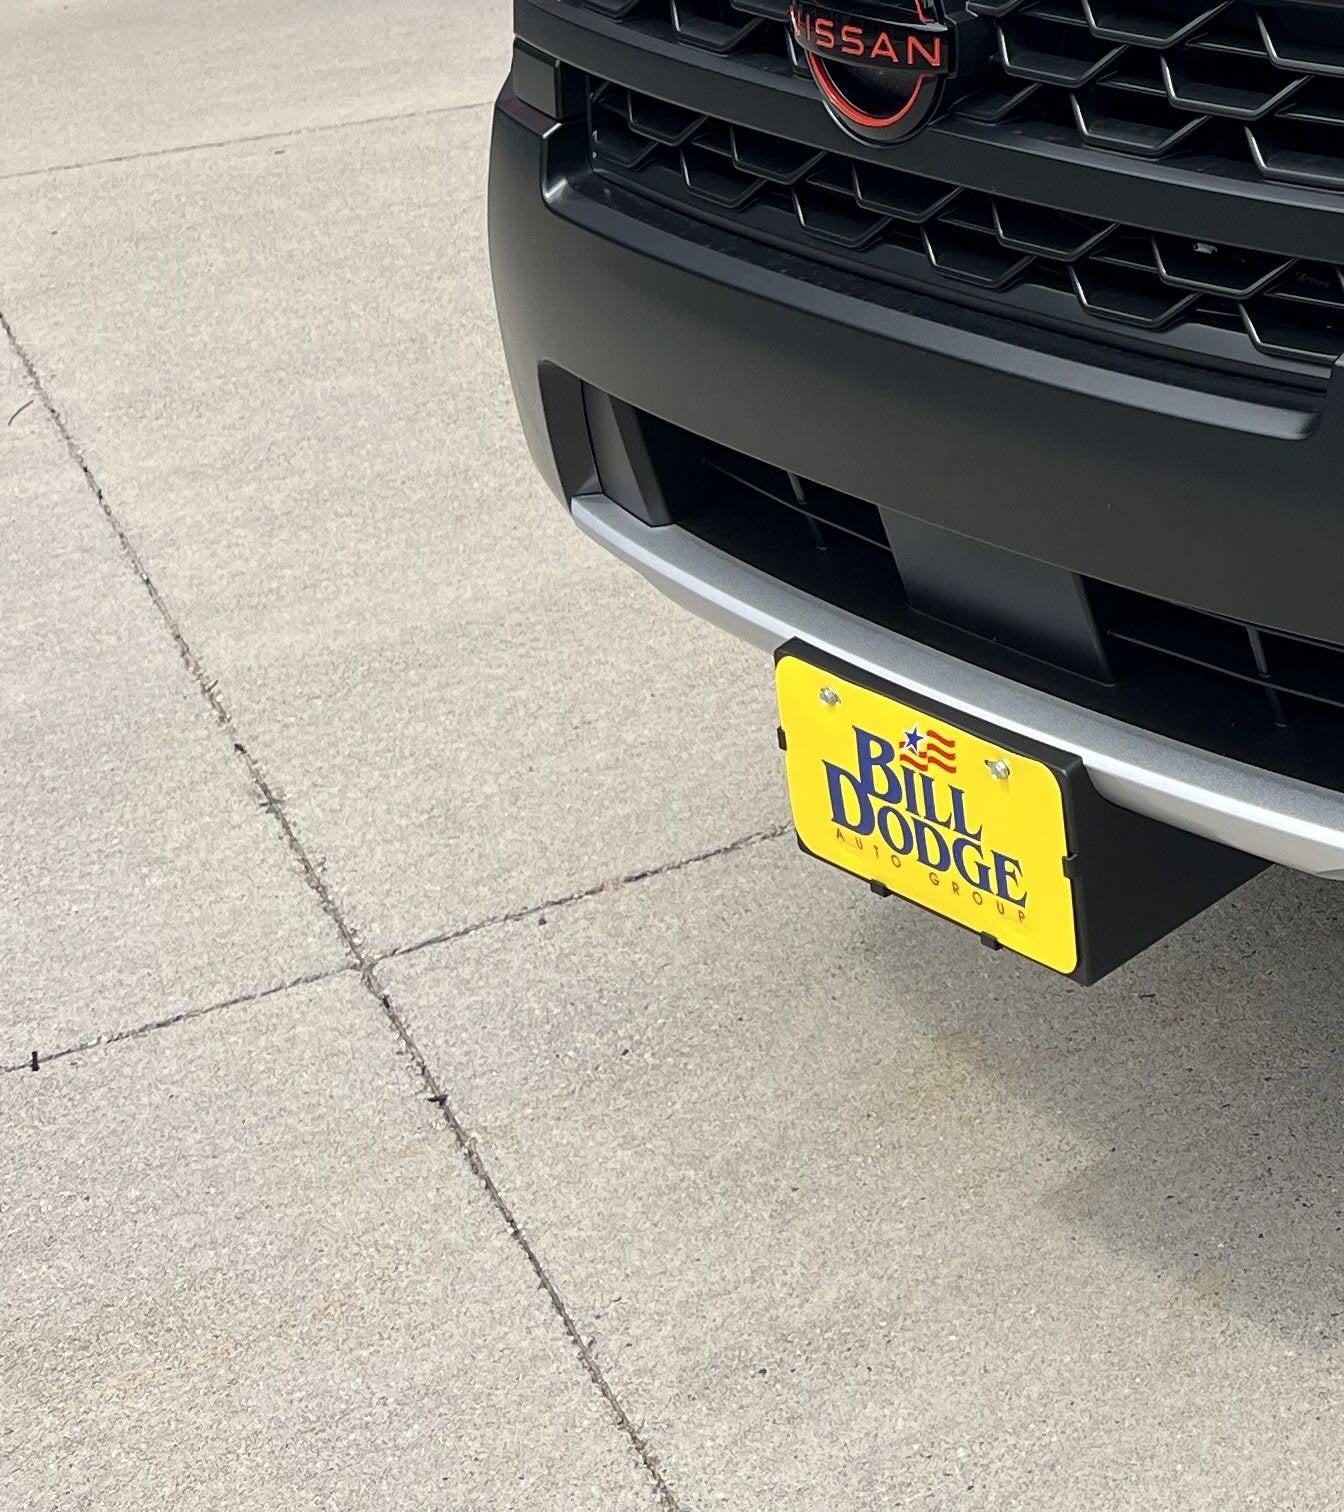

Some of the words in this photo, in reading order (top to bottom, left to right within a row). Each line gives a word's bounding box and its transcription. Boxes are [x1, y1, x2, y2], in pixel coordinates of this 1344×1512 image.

[789, 4, 942, 67] NISSAN
[821, 759, 1027, 908] DODGE
[852, 725, 983, 841] BILL
[836, 828, 901, 869] AUTO
[929, 872, 1027, 922] GROUP
